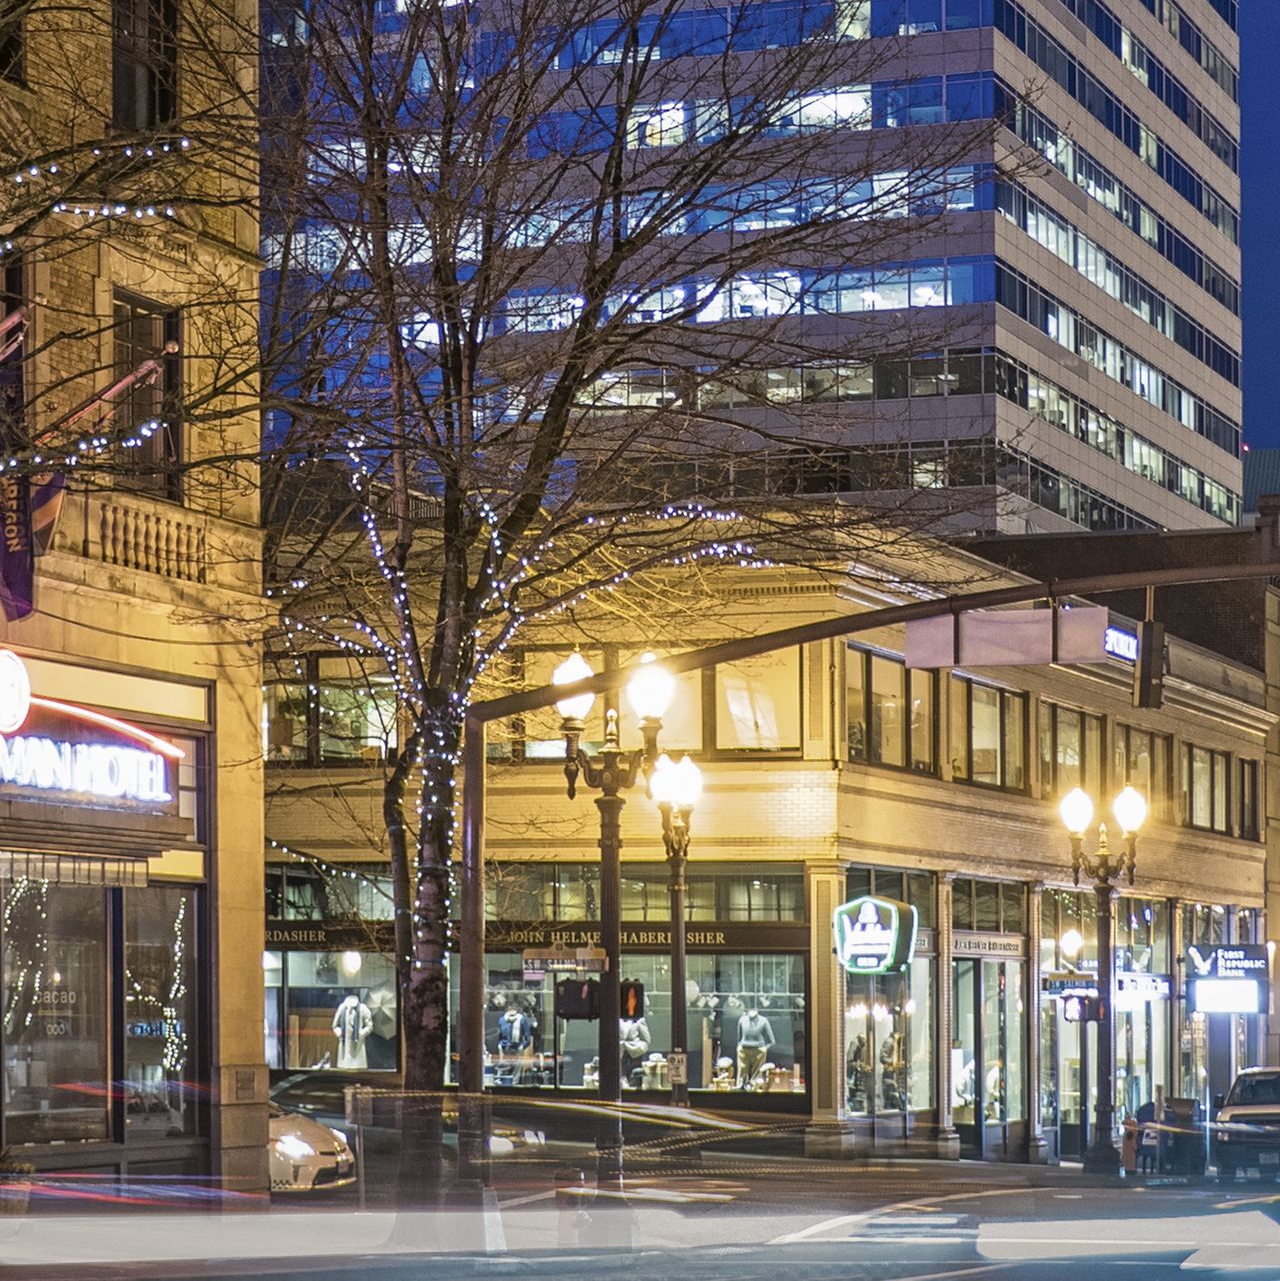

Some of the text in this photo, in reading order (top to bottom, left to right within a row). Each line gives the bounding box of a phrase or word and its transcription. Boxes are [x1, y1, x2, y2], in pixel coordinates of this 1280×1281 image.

[74, 743, 173, 802] HOTEL
[507, 931, 726, 944] JOHN HELME HABERSHER
[1217, 948, 1245, 959] FIRST
[1217, 958, 1266, 968] REPUBLIC
[1217, 967, 1246, 977] BANK
